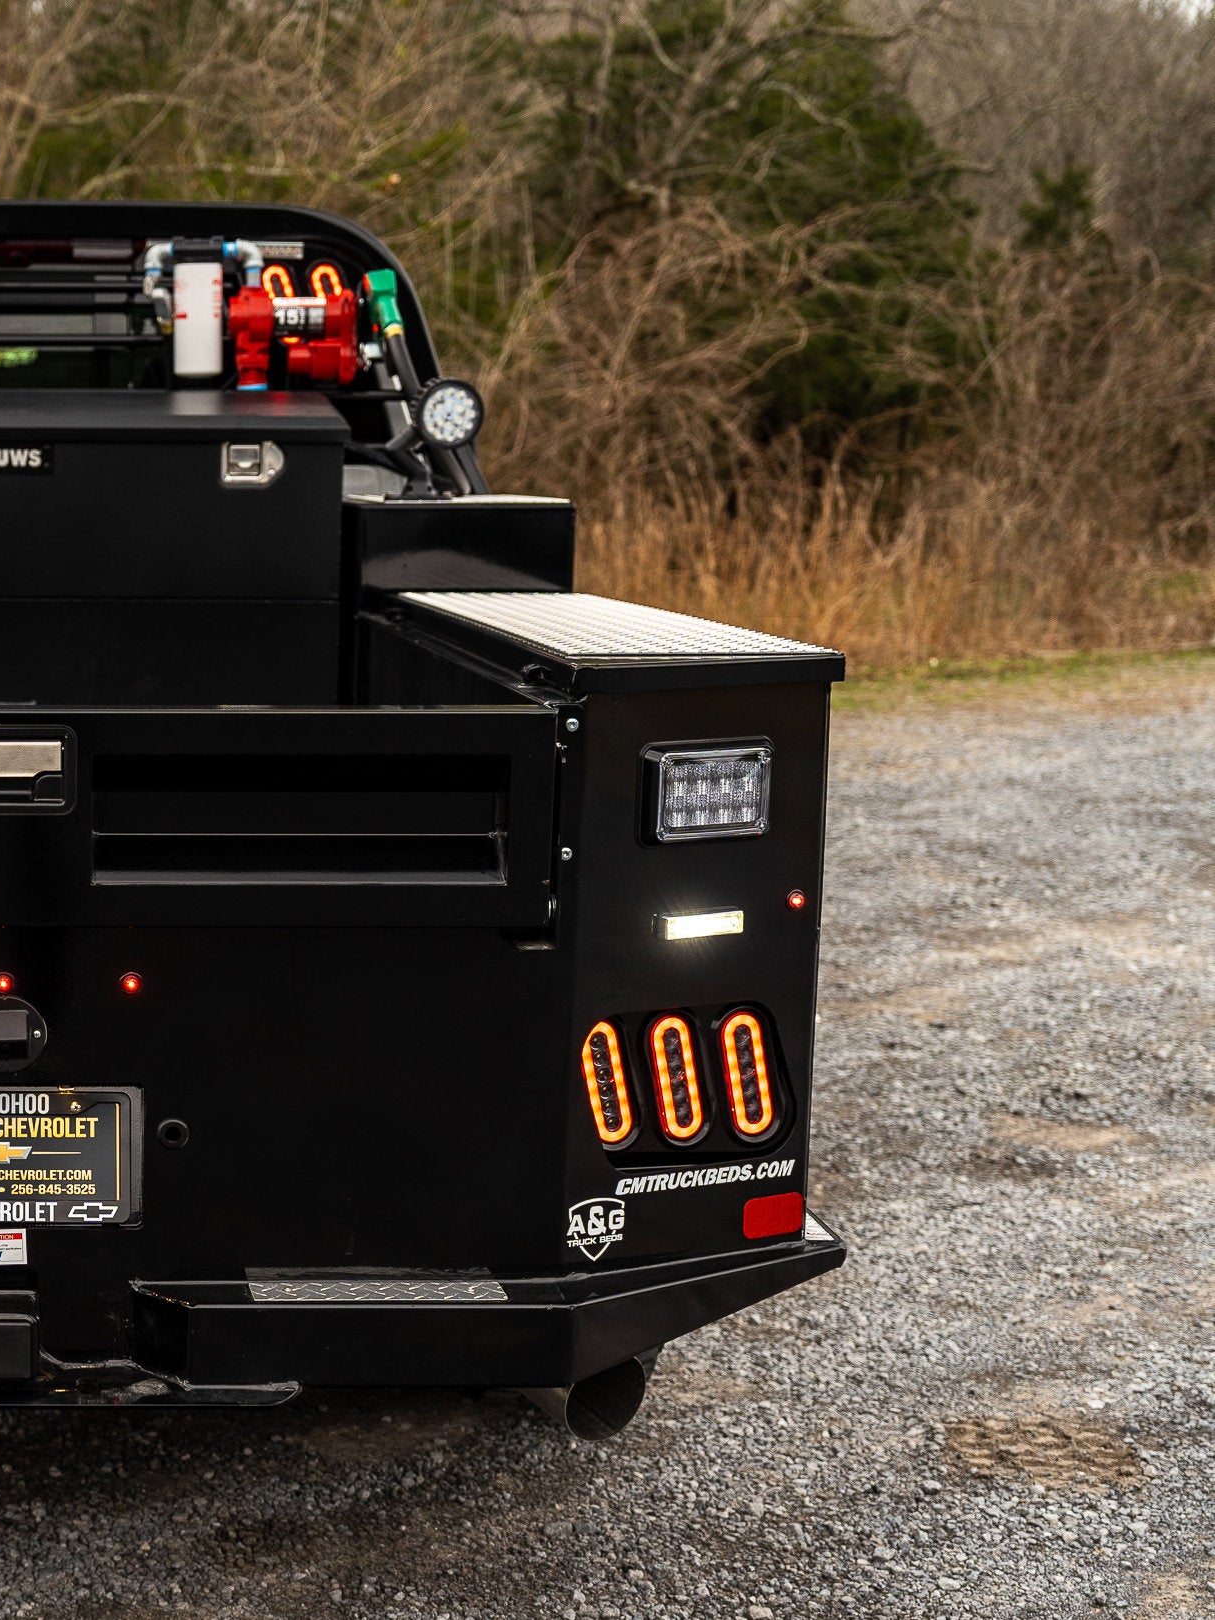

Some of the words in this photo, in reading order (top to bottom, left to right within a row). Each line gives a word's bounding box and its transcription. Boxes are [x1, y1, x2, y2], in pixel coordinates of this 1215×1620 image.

[615, 1159, 795, 1196] CMTRUCKBEDS.COM
[10, 1184, 96, 1196] 256-845-3525
[566, 1205, 625, 1237] A&G
[567, 1237, 597, 1248] TRUCK
[599, 1233, 623, 1244] BEDS
